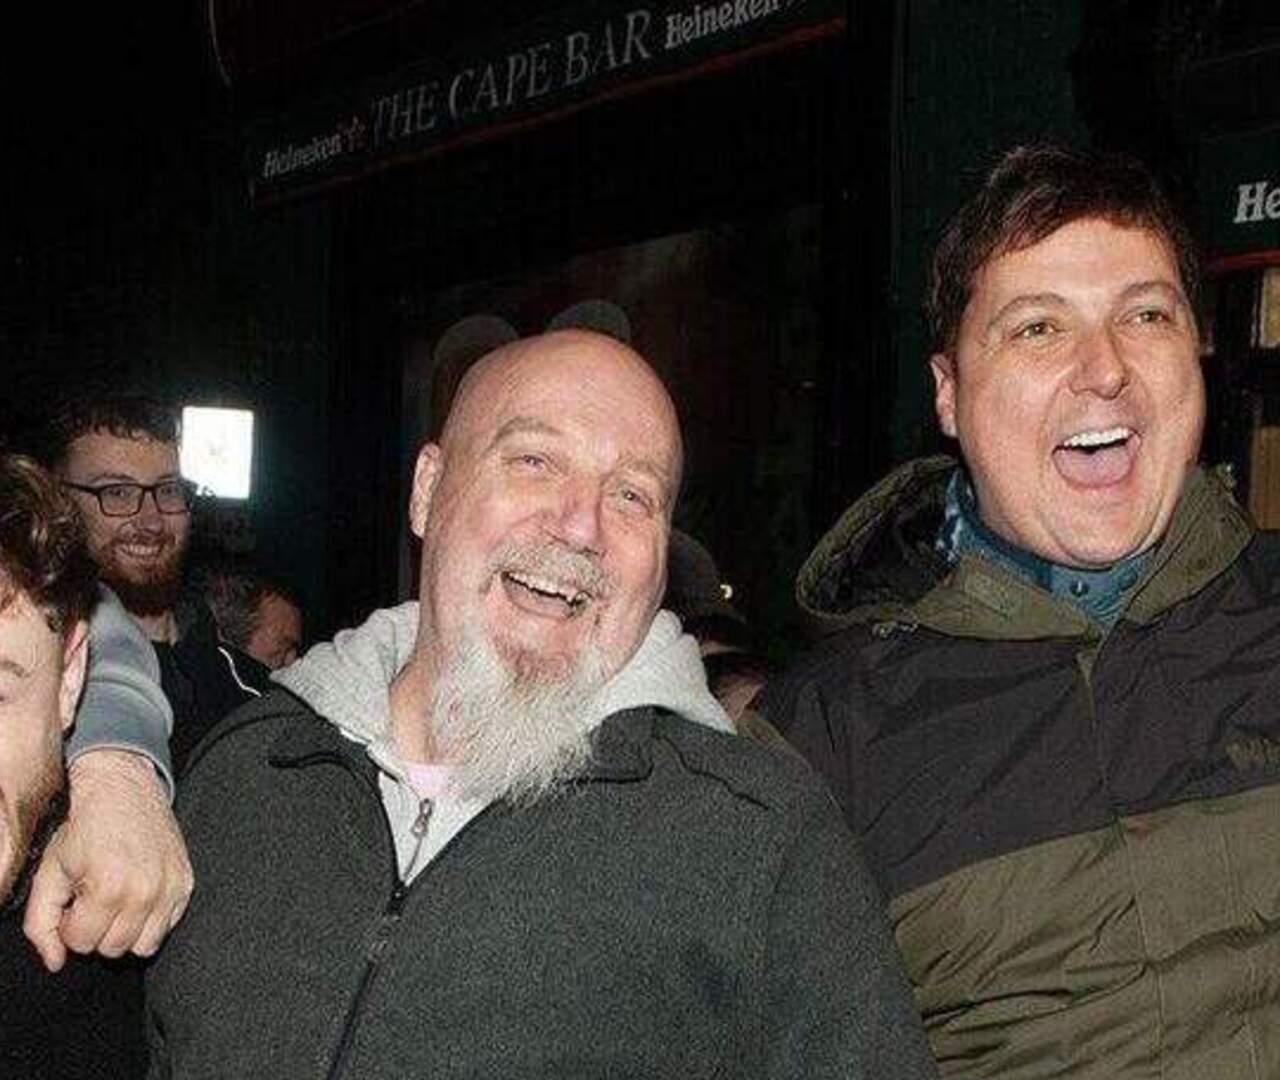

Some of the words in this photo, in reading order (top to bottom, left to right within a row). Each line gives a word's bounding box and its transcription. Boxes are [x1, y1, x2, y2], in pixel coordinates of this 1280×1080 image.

[370, 82, 437, 148] THE
[448, 42, 552, 119] CAPE
[565, 8, 653, 85] BAR
